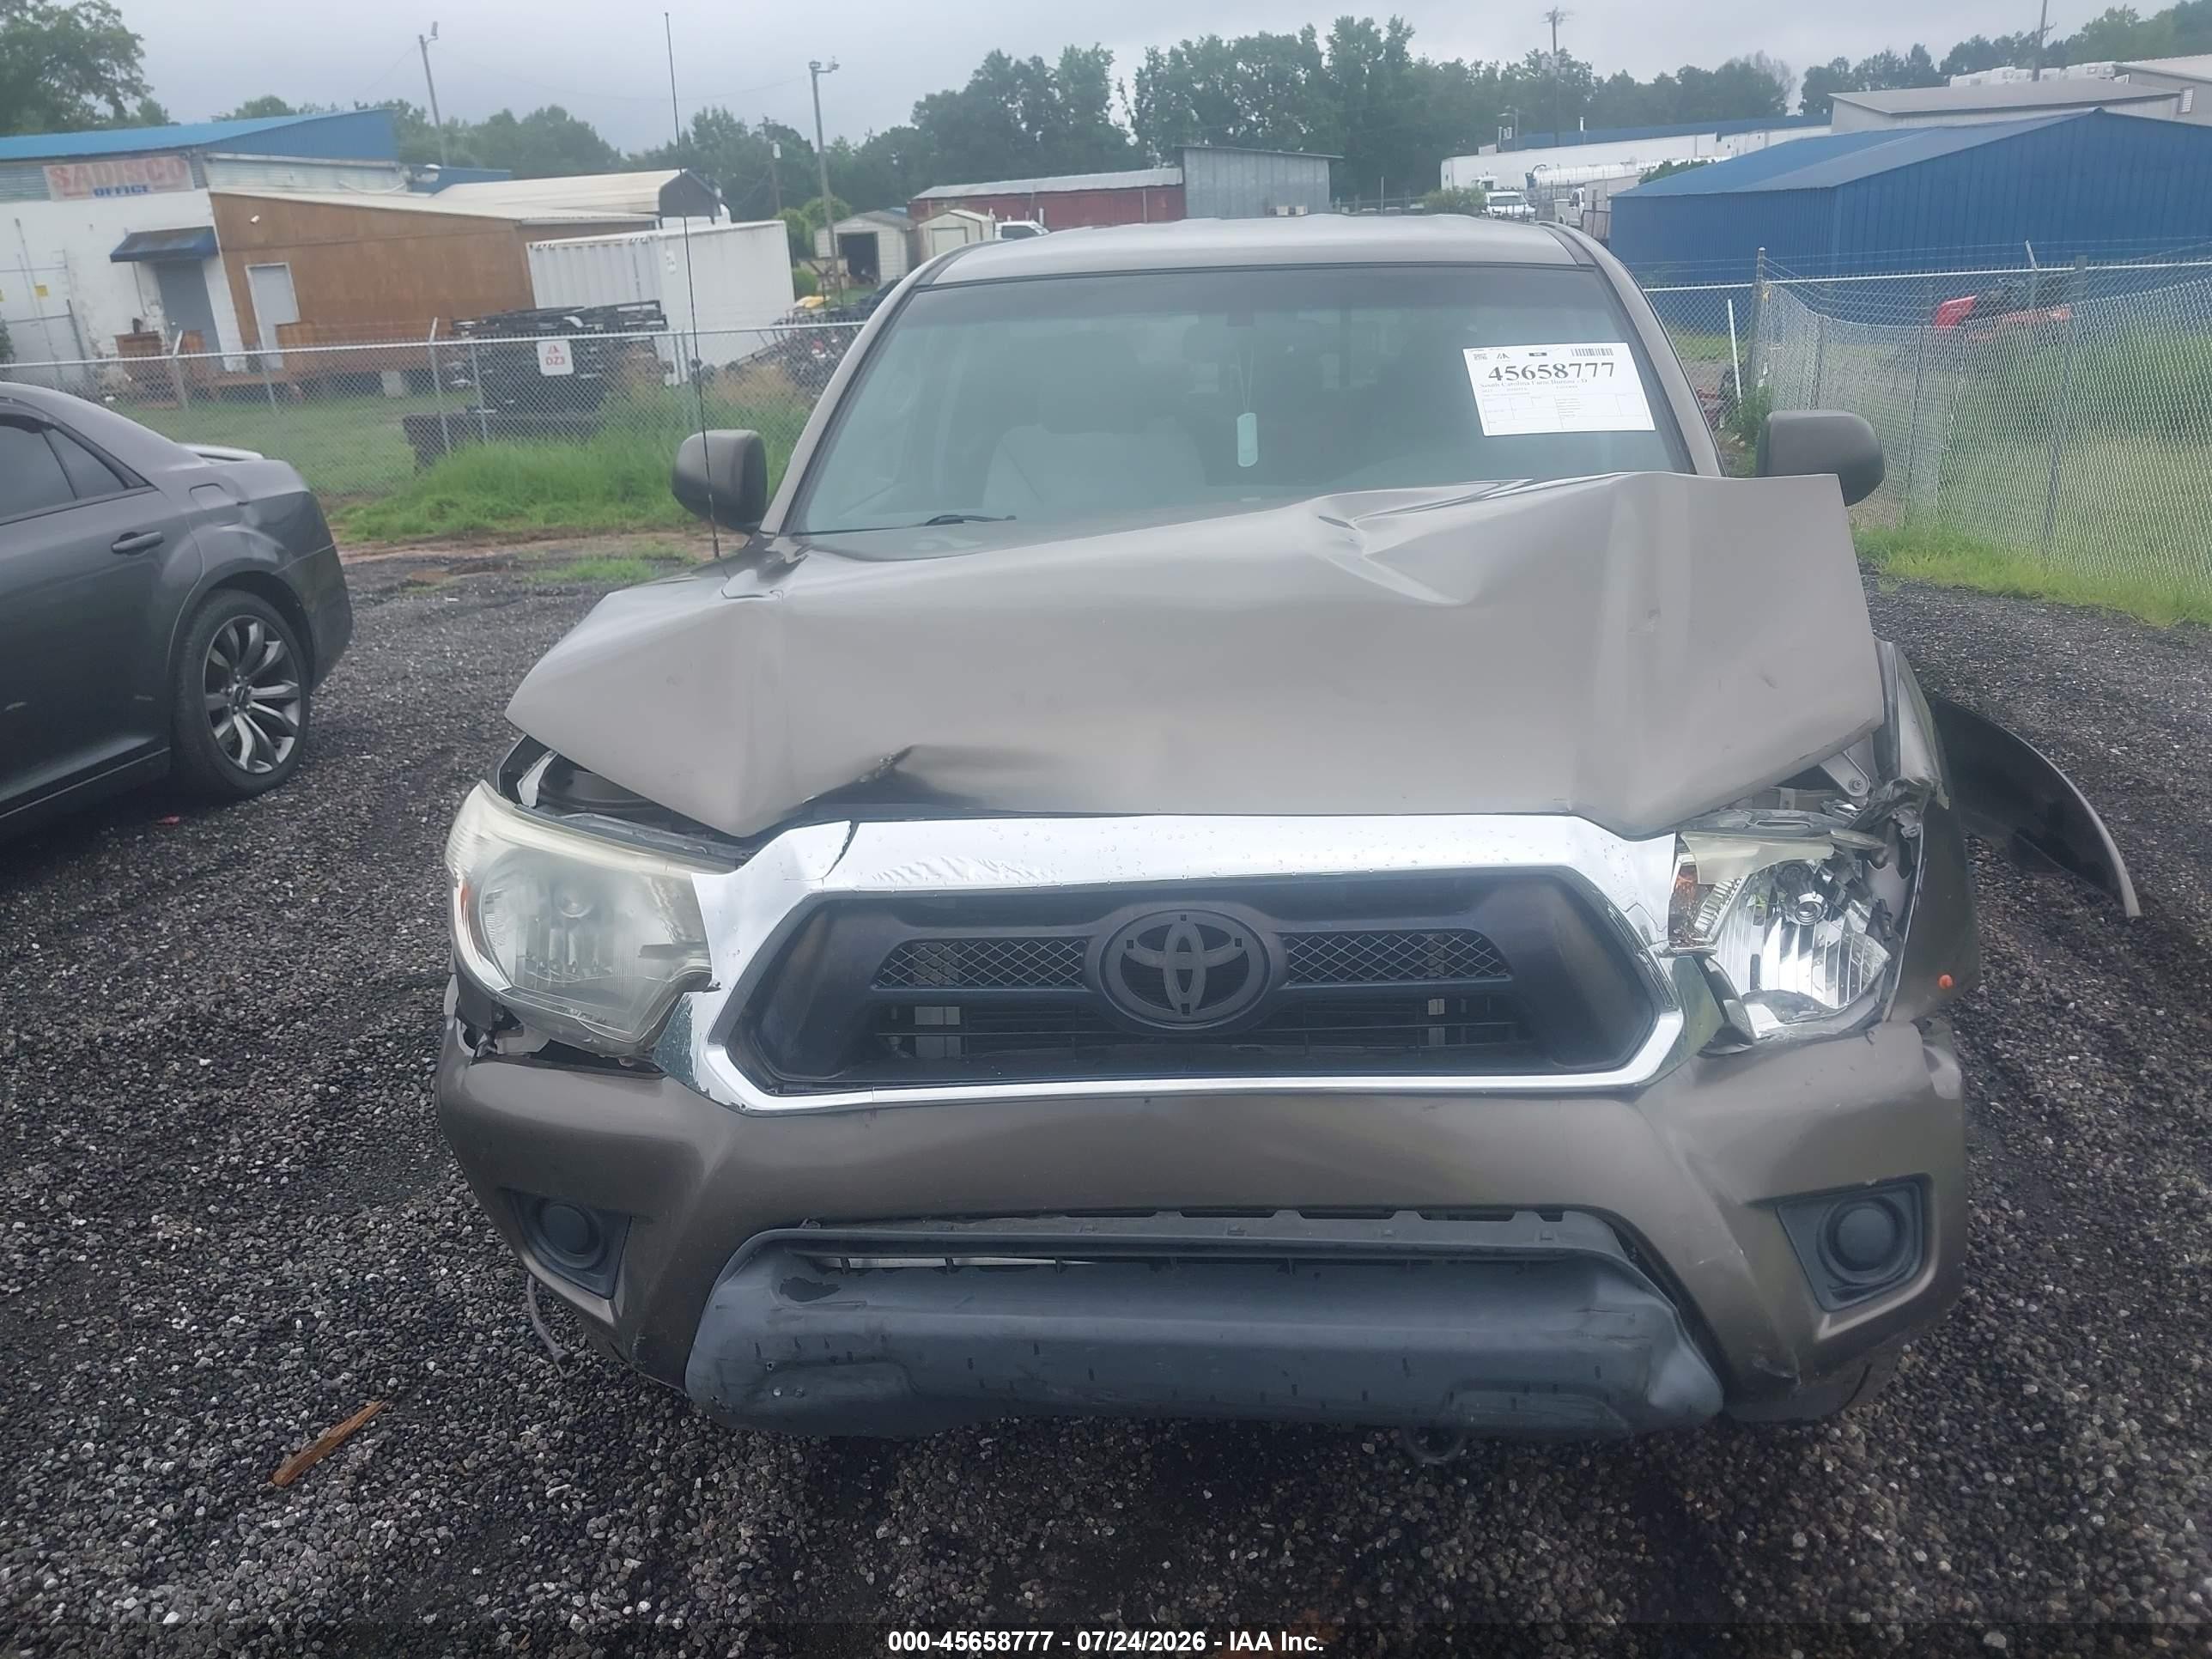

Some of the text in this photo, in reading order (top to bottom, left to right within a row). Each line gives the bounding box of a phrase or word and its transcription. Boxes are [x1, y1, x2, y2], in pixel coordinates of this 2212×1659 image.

[49, 156, 187, 186] SADISCO
[93, 185, 149, 198] OFFICE
[1487, 362, 1615, 381] 45658777
